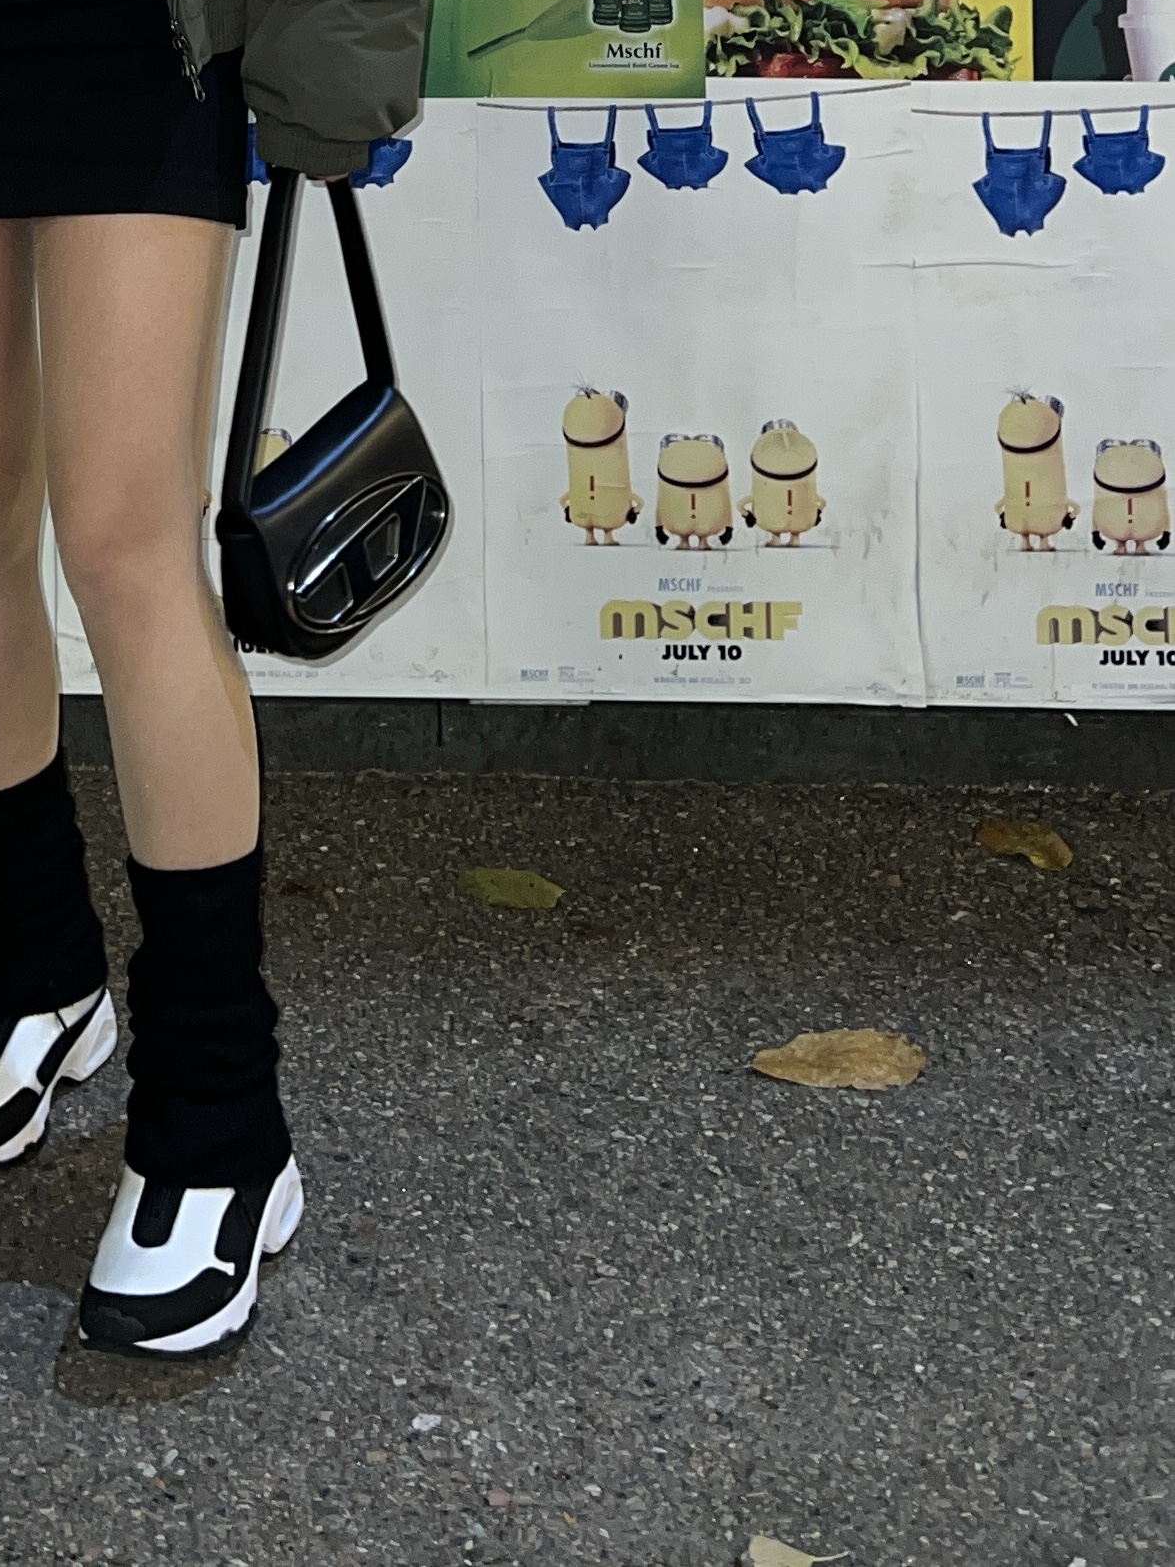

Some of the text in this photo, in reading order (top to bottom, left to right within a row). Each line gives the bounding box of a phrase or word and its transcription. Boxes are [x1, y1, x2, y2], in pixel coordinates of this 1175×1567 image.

[607, 43, 662, 58] Mschf
[658, 578, 702, 592] MSCHF
[1095, 583, 1139, 597] MSCHF
[600, 599, 803, 641] MSCHF
[1036, 605, 1175, 646] MSC
[661, 645, 742, 661] JULY 10
[1099, 650, 1149, 666] JULY
